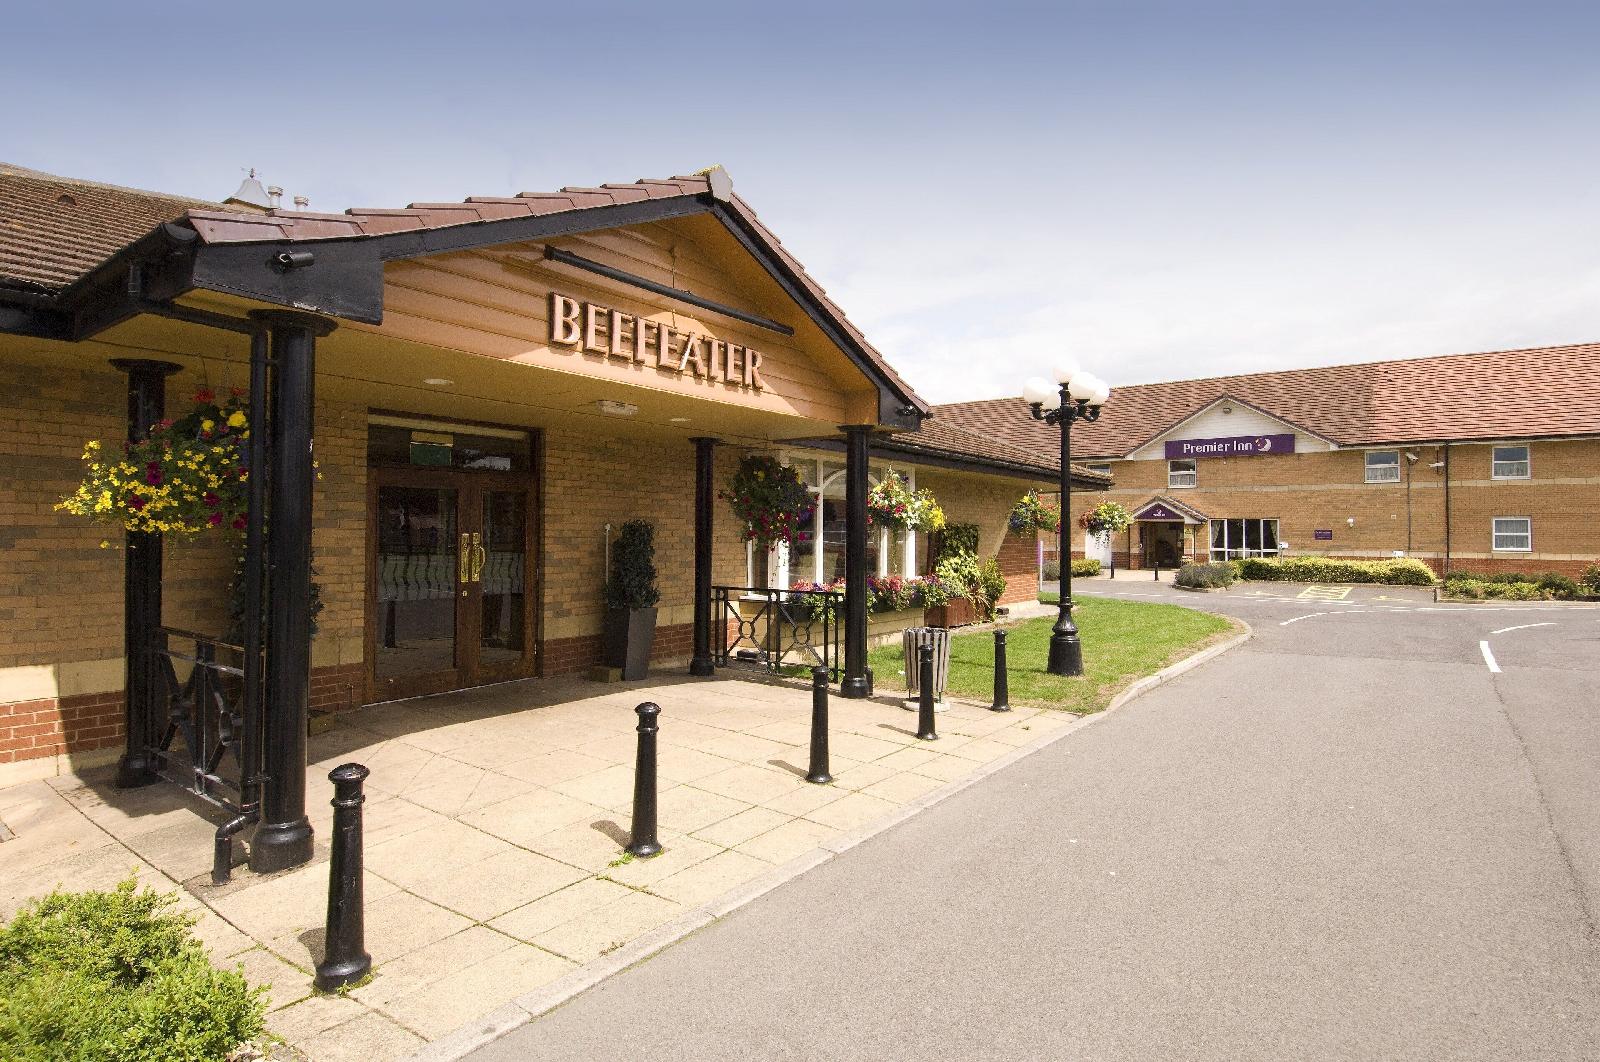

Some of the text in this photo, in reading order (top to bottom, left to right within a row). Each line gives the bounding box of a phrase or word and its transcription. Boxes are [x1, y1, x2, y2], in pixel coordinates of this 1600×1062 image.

[550, 291, 763, 390] BEEFEATER
[1183, 440, 1253, 454] Premier Inn
